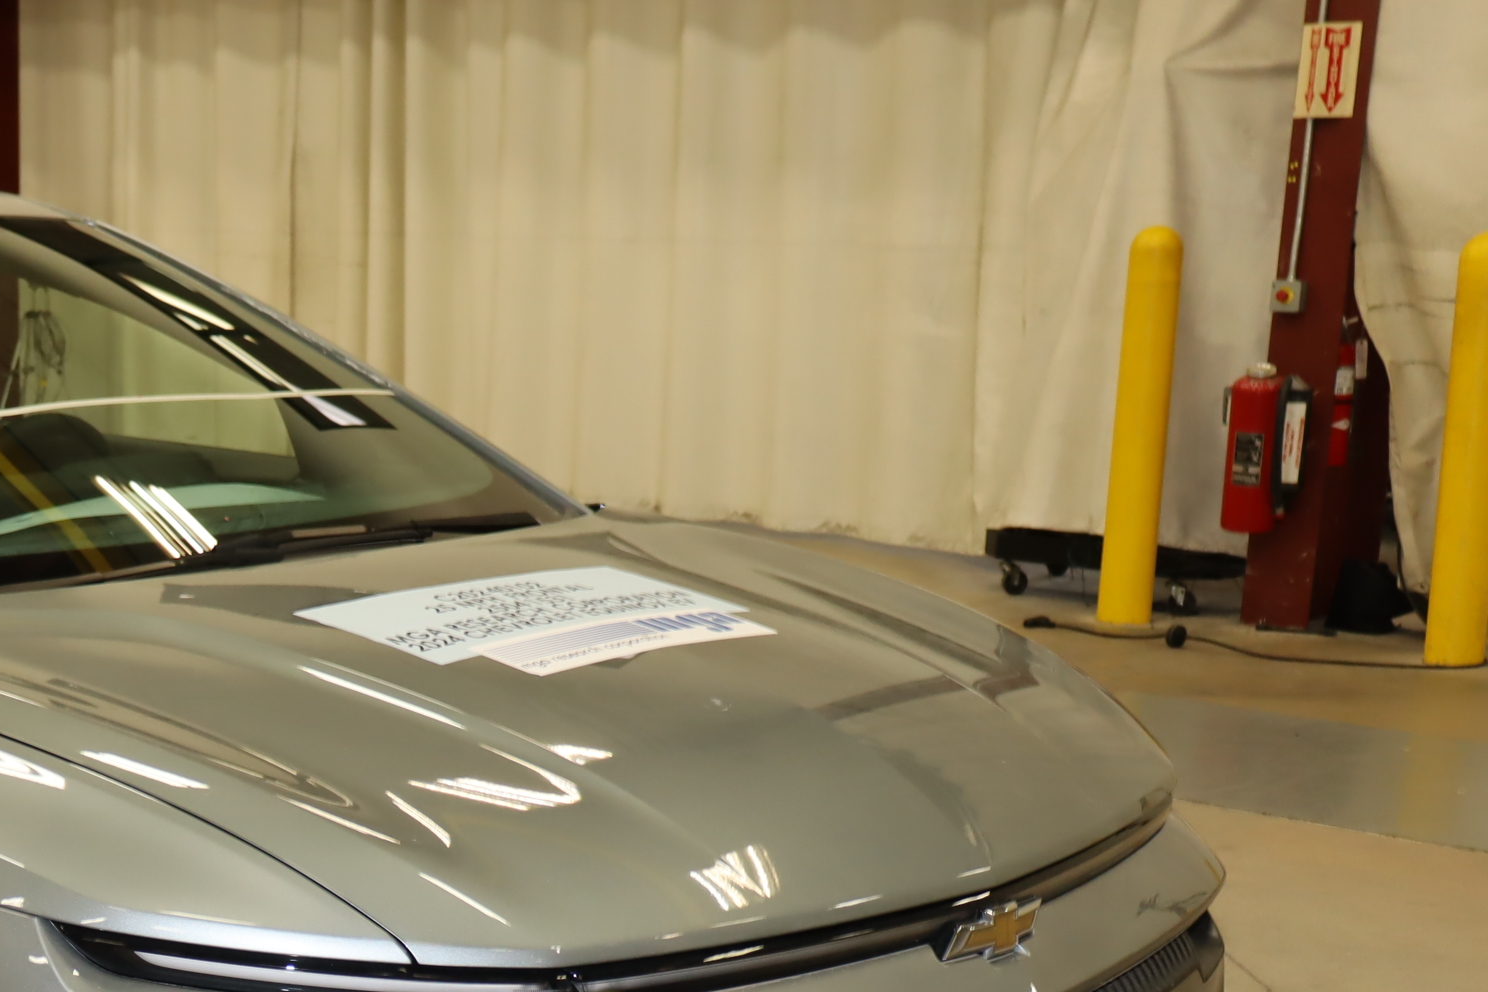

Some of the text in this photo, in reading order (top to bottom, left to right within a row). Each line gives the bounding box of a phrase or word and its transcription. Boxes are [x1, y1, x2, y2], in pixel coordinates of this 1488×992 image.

[385, 590, 693, 646] MGA RESEARCH CORPORATION
[424, 604, 457, 614] 25
[454, 596, 505, 608] MPH
[408, 634, 466, 652] 2024
[464, 612, 584, 639] CHEVROLET
[579, 600, 670, 618] EQUINOX
[520, 658, 551, 669] mga
[552, 646, 601, 662] research
